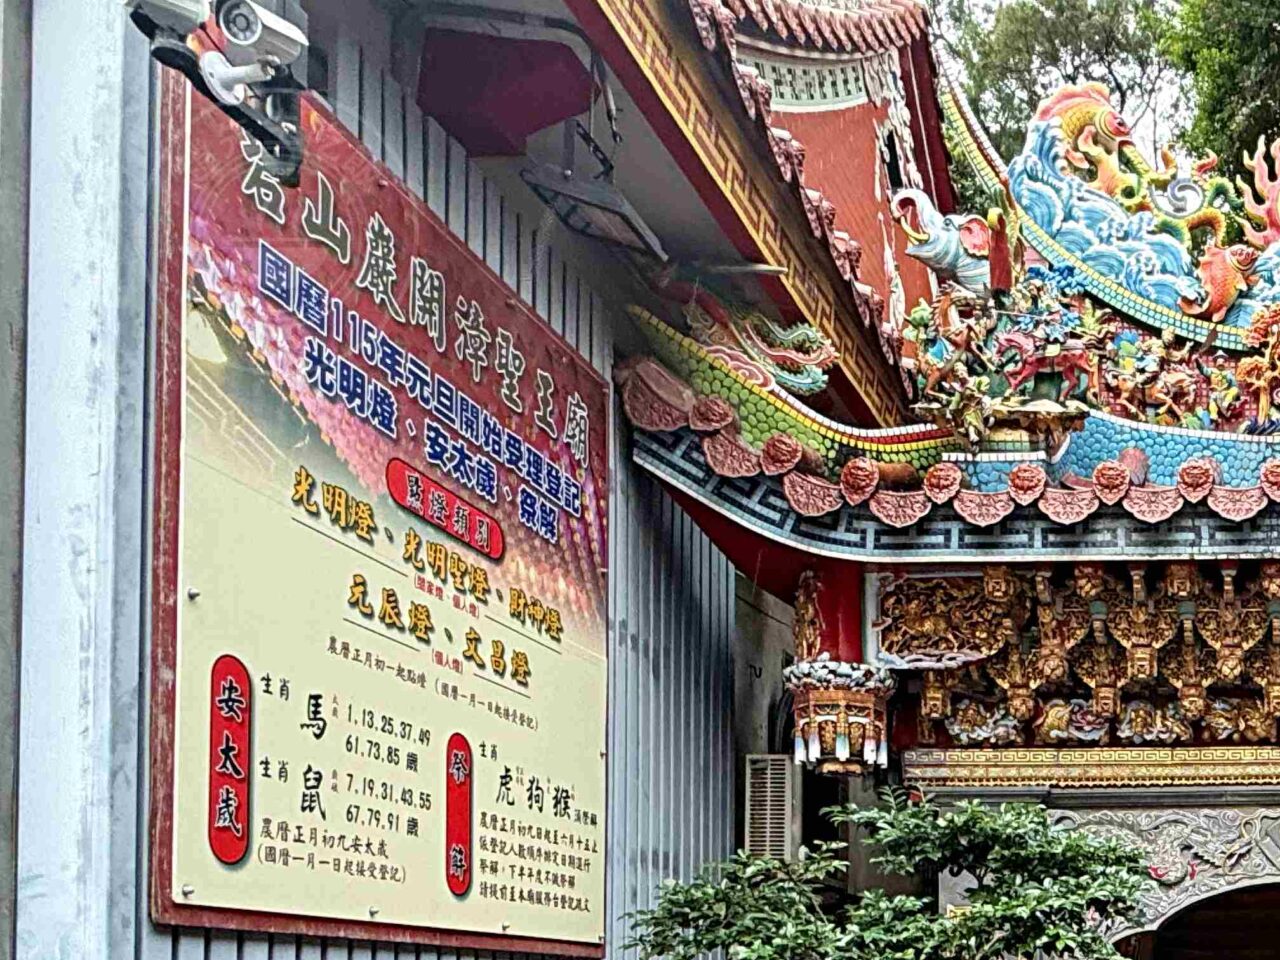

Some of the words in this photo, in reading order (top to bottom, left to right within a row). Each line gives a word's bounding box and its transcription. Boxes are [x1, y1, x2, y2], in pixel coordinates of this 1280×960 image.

[259, 239, 582, 516] 國曆115年元旦開始受理登記
[304, 337, 558, 543] 光明燈、安太歲、祭解
[347, 574, 531, 686] 元辰燈、文昌燈
[260, 673, 290, 701] 生肖
[300, 694, 327, 740] 馬
[215, 676, 246, 836] 安太歲
[259, 756, 289, 783] 生肖
[301, 764, 326, 821] 鼠
[496, 765, 515, 806] 虎
[526, 776, 544, 813] 狗
[552, 785, 571, 820] 猴
